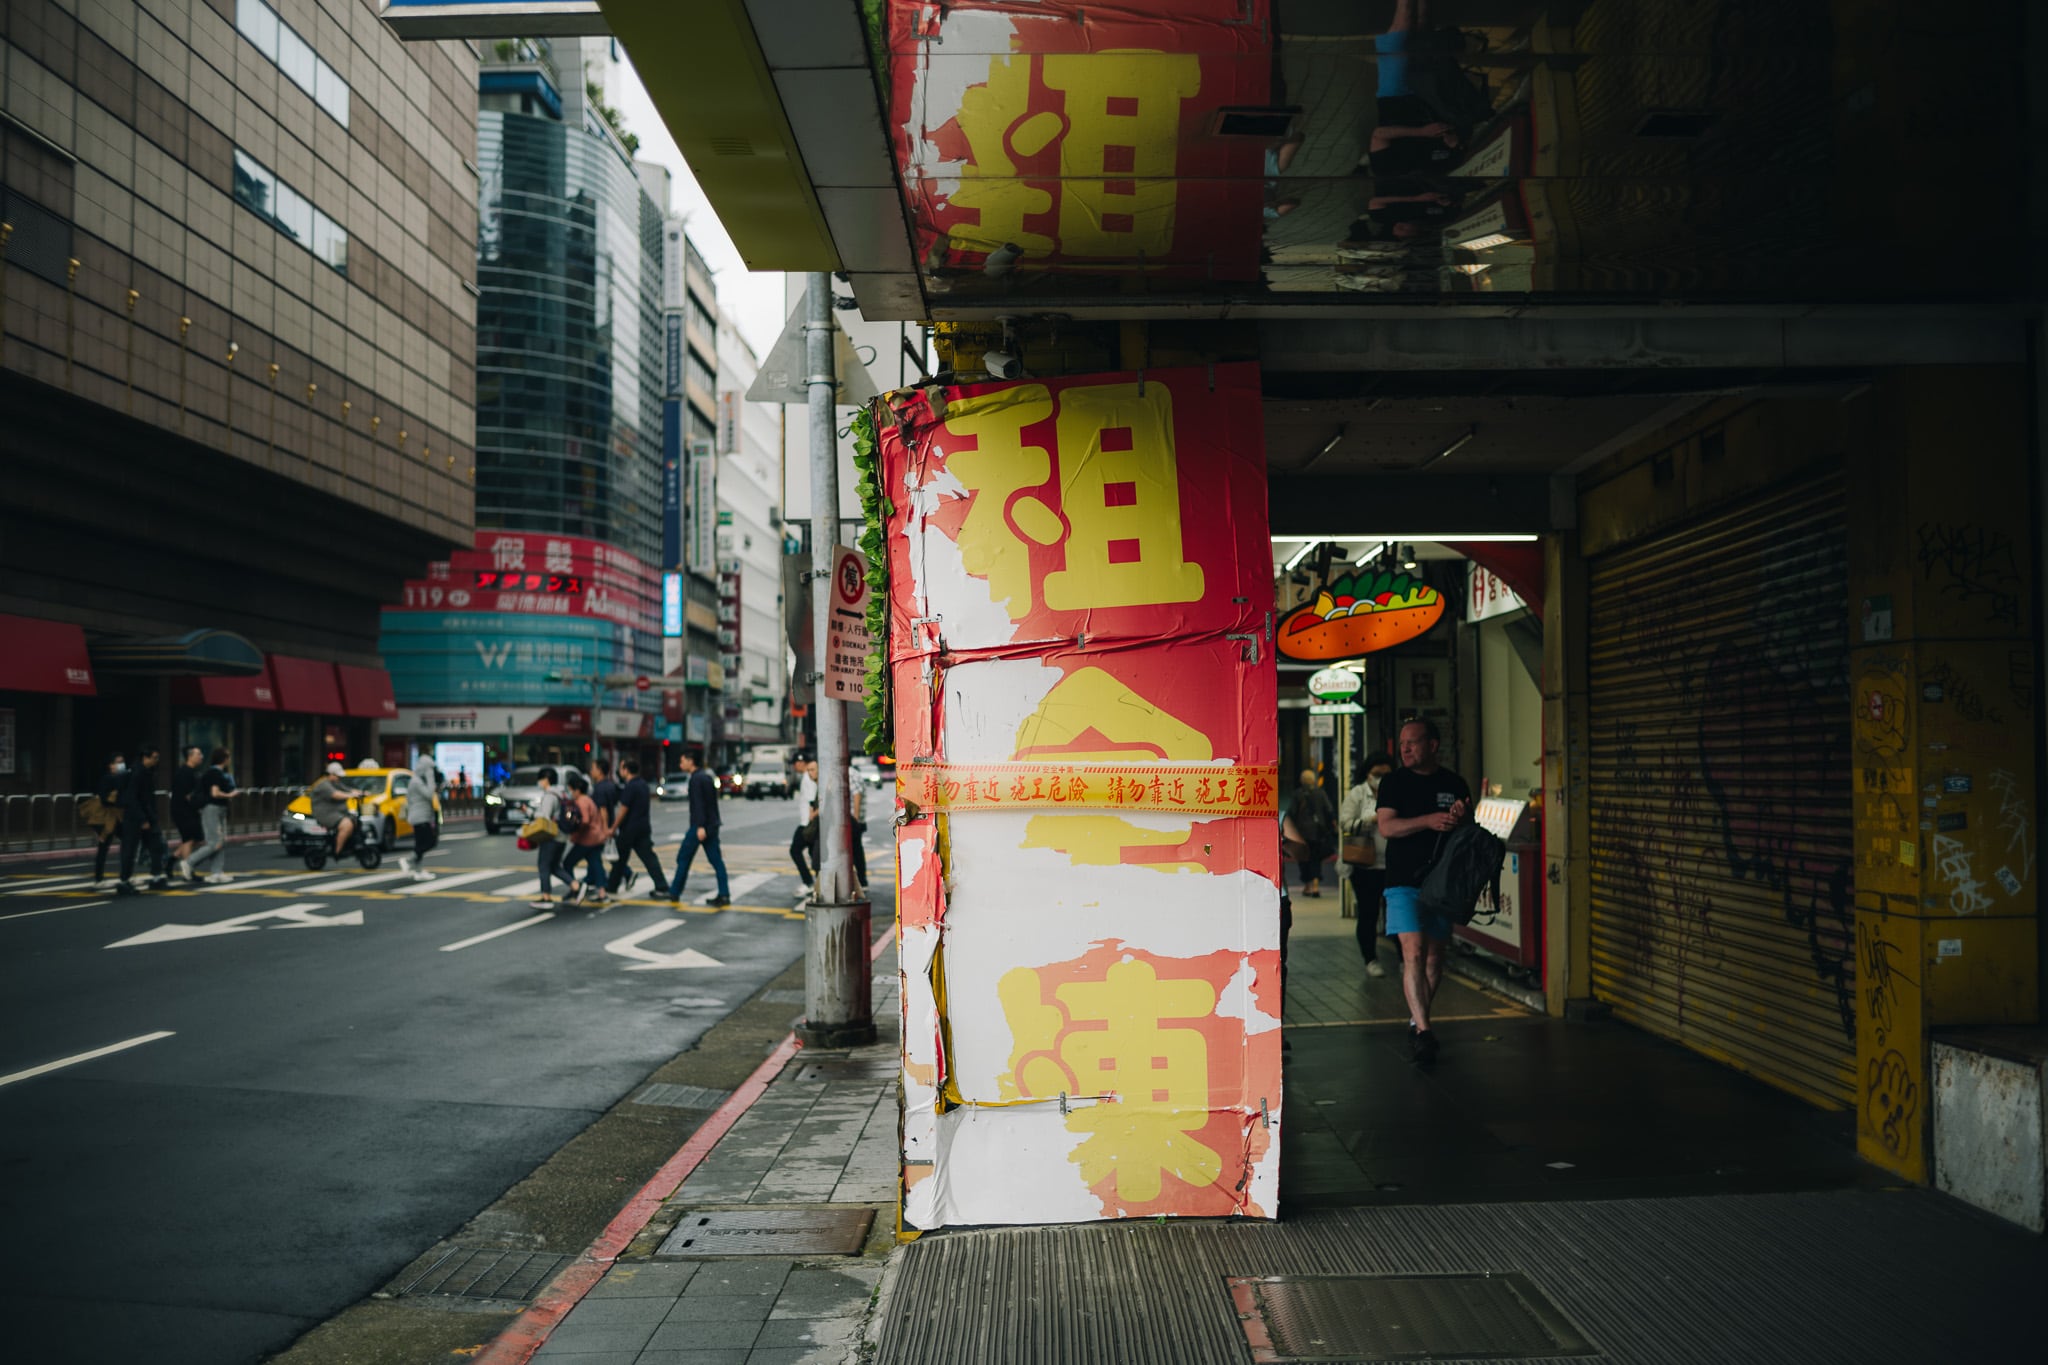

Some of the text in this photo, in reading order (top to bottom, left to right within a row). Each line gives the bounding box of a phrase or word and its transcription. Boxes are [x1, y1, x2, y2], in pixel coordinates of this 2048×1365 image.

[491, 536, 573, 574] 假髮
[844, 565, 858, 592] 停
[405, 586, 444, 607] 119
[849, 682, 863, 693] 110
[923, 773, 1001, 803] 請勿靠近
[1010, 775, 1088, 803] 施工危險
[1107, 774, 1274, 806] 請勿靠近 施工危險
